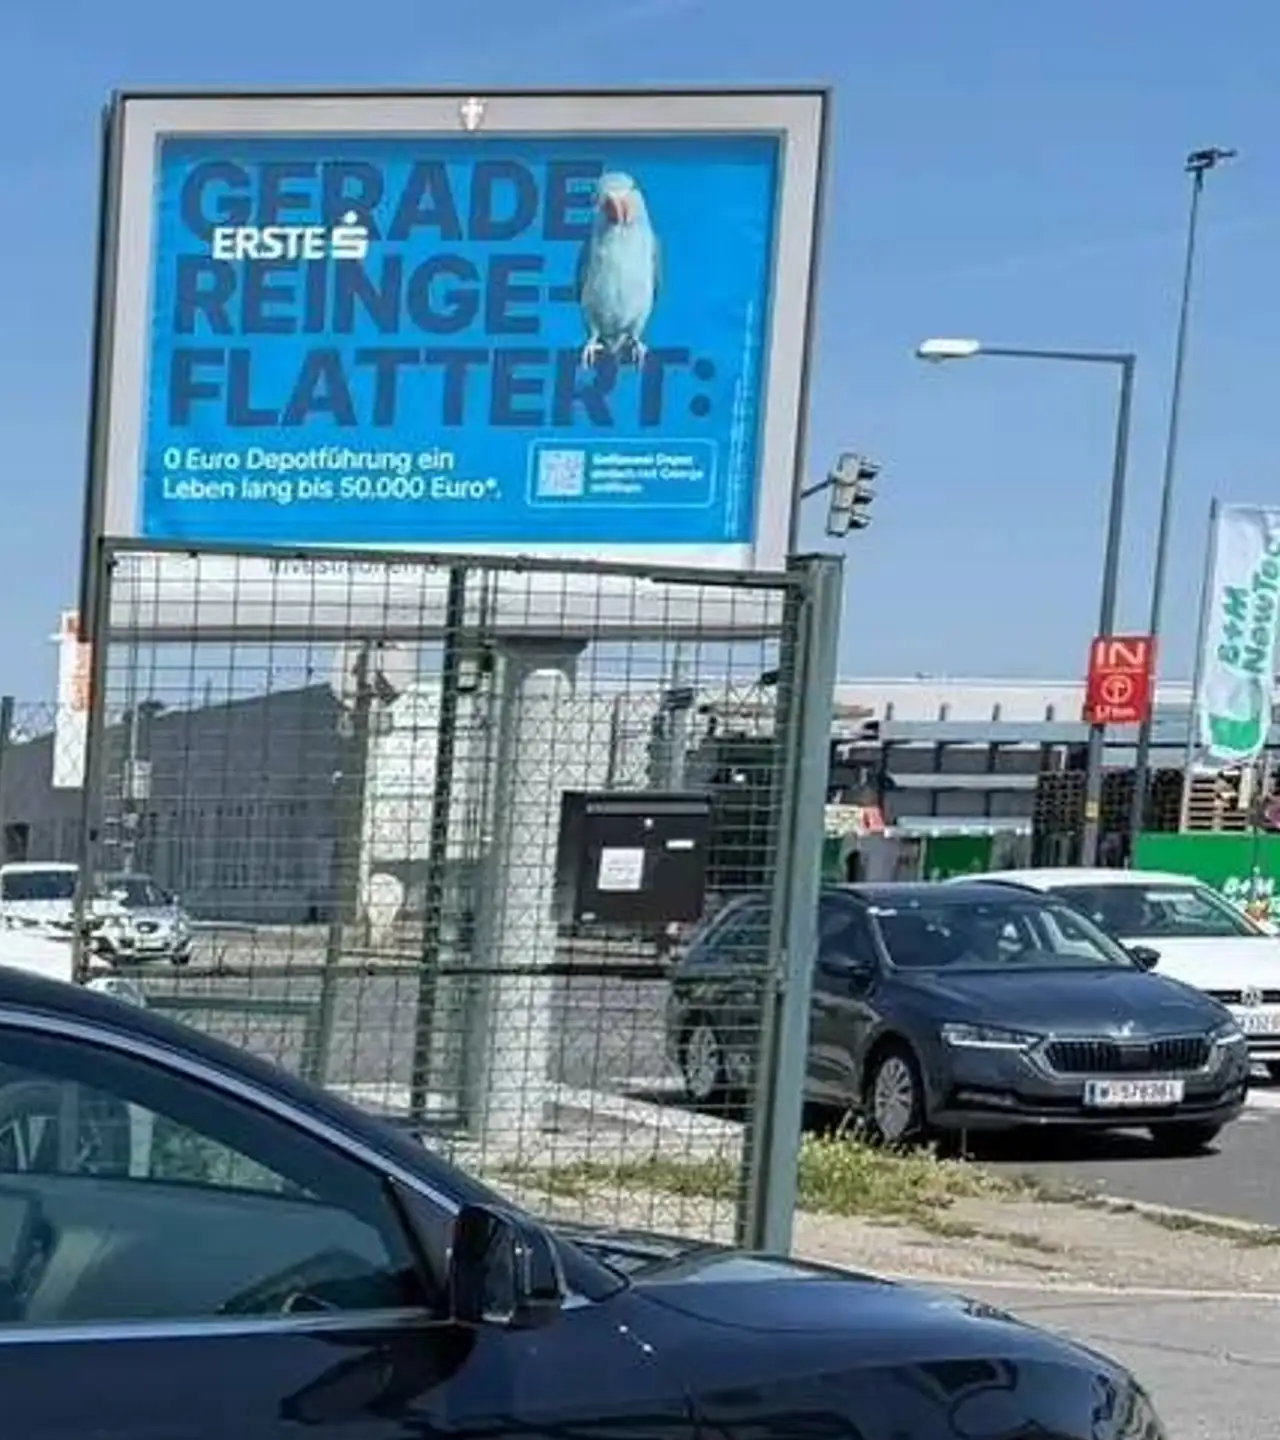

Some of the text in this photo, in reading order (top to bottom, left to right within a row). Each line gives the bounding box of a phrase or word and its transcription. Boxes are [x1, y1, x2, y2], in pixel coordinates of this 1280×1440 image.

[180, 160, 605, 242] GERADE
[212, 227, 326, 261] ERSTE
[173, 253, 580, 335] REINGE-
[167, 346, 716, 429] FLATTERT:
[163, 447, 454, 475] 0 Euro Depotführung ein
[162, 477, 235, 499] Leben
[242, 477, 292, 505] lang
[298, 477, 333, 499] bis
[341, 477, 425, 500] 50.000
[1095, 641, 1146, 665] IN
